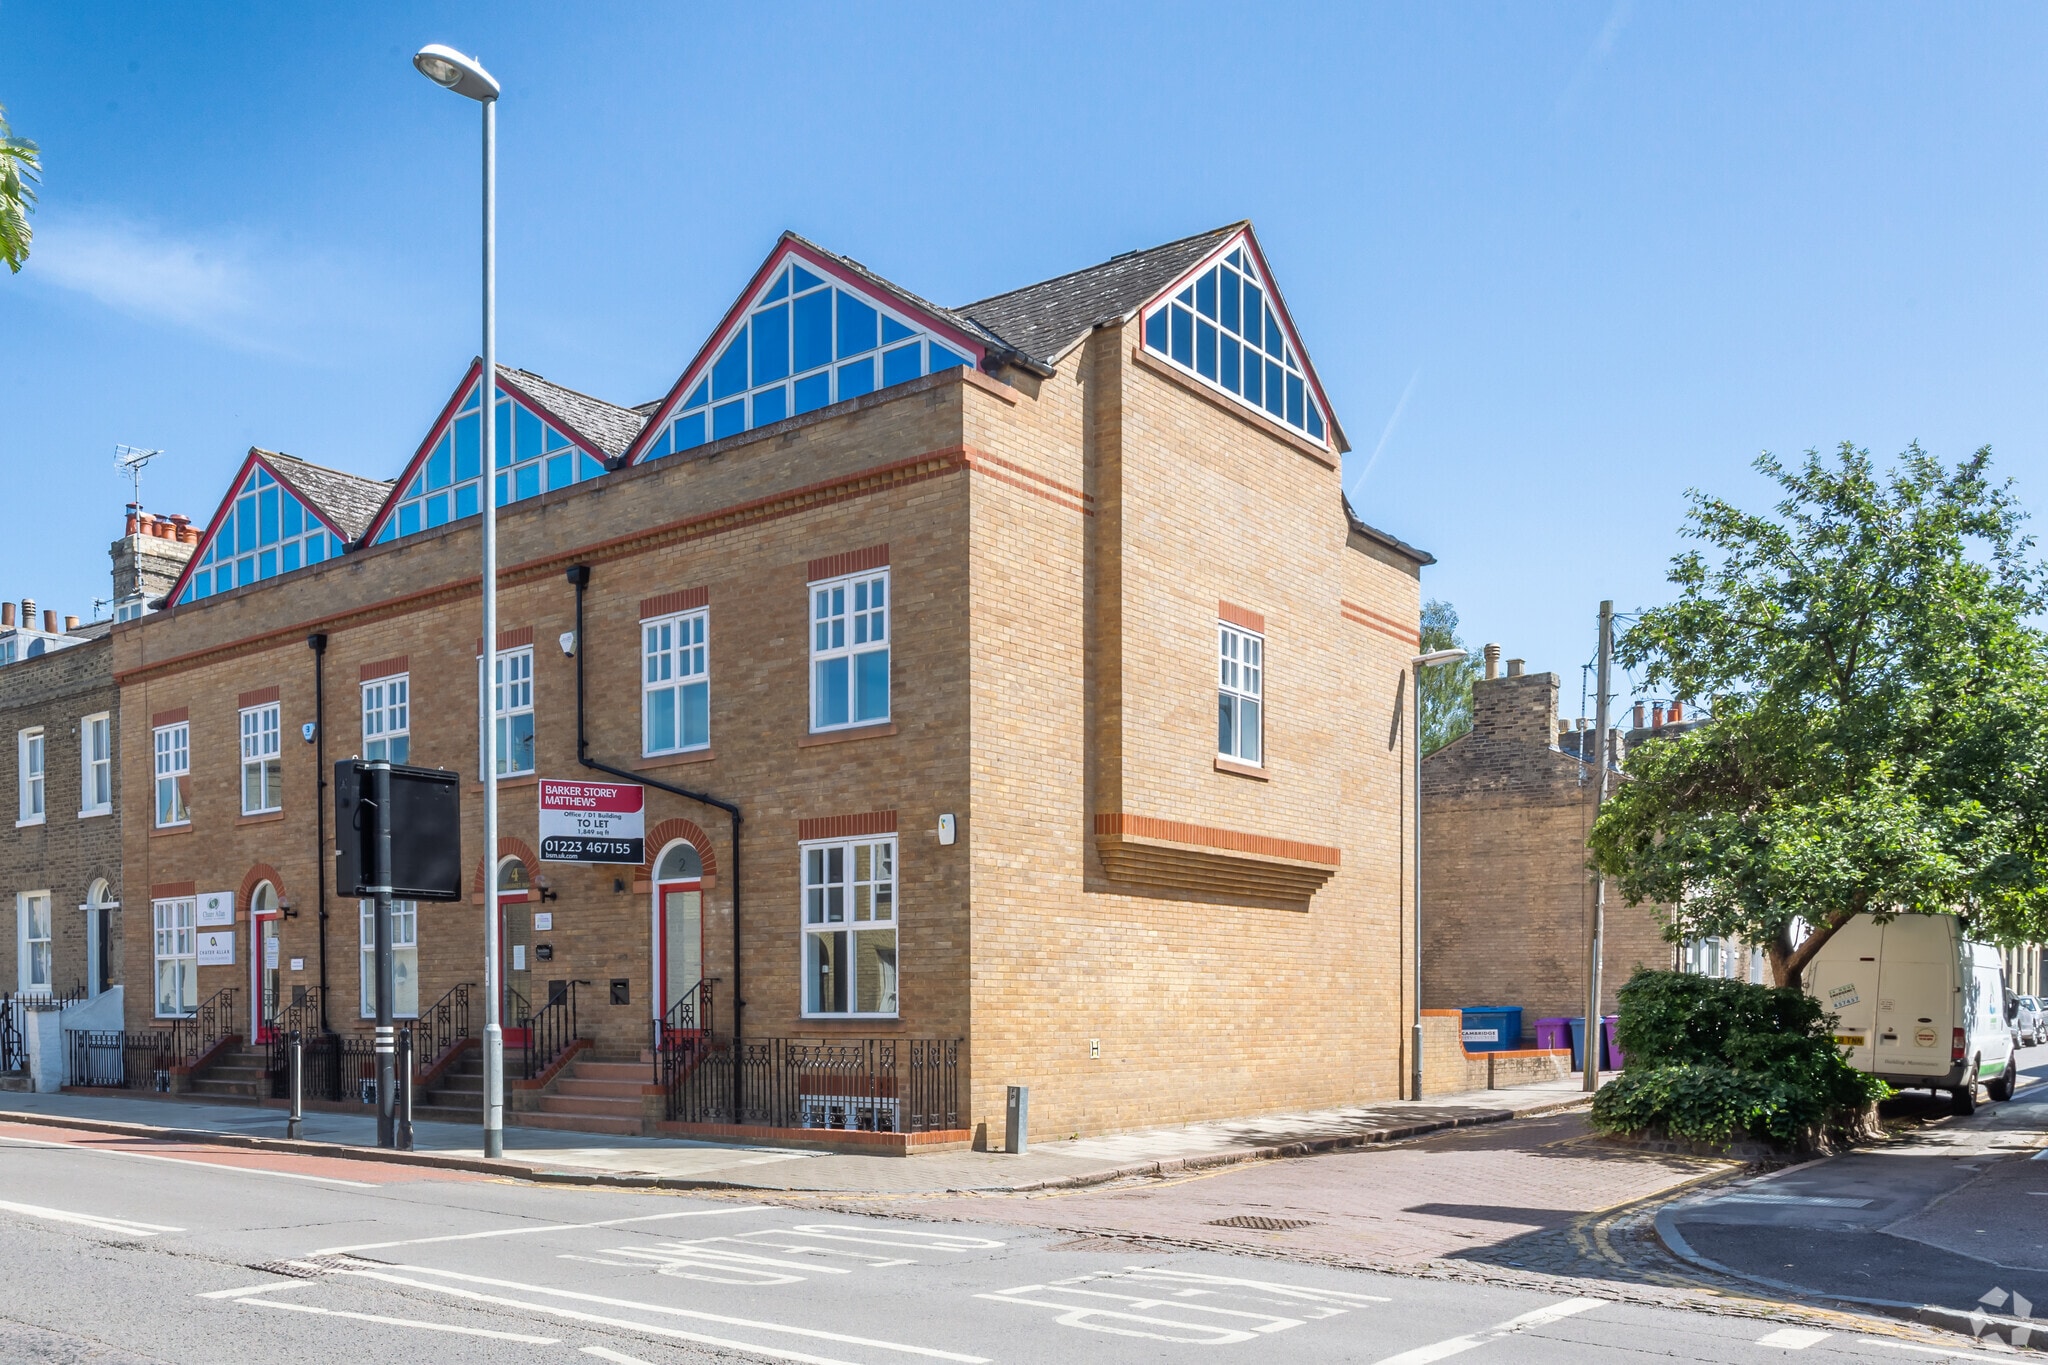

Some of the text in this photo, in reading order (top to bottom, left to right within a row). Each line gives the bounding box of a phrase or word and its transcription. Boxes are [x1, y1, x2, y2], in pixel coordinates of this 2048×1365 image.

[545, 785, 618, 798] BARKER STOREY
[545, 796, 597, 807] MATTHEWS
[577, 819, 609, 829] TO LET
[545, 840, 631, 855] 01223 467155
[679, 858, 686, 872] 2
[511, 867, 519, 882] 4
[556, 1224, 1007, 1286] CLEAR
[972, 1266, 1392, 1345] KEEP
